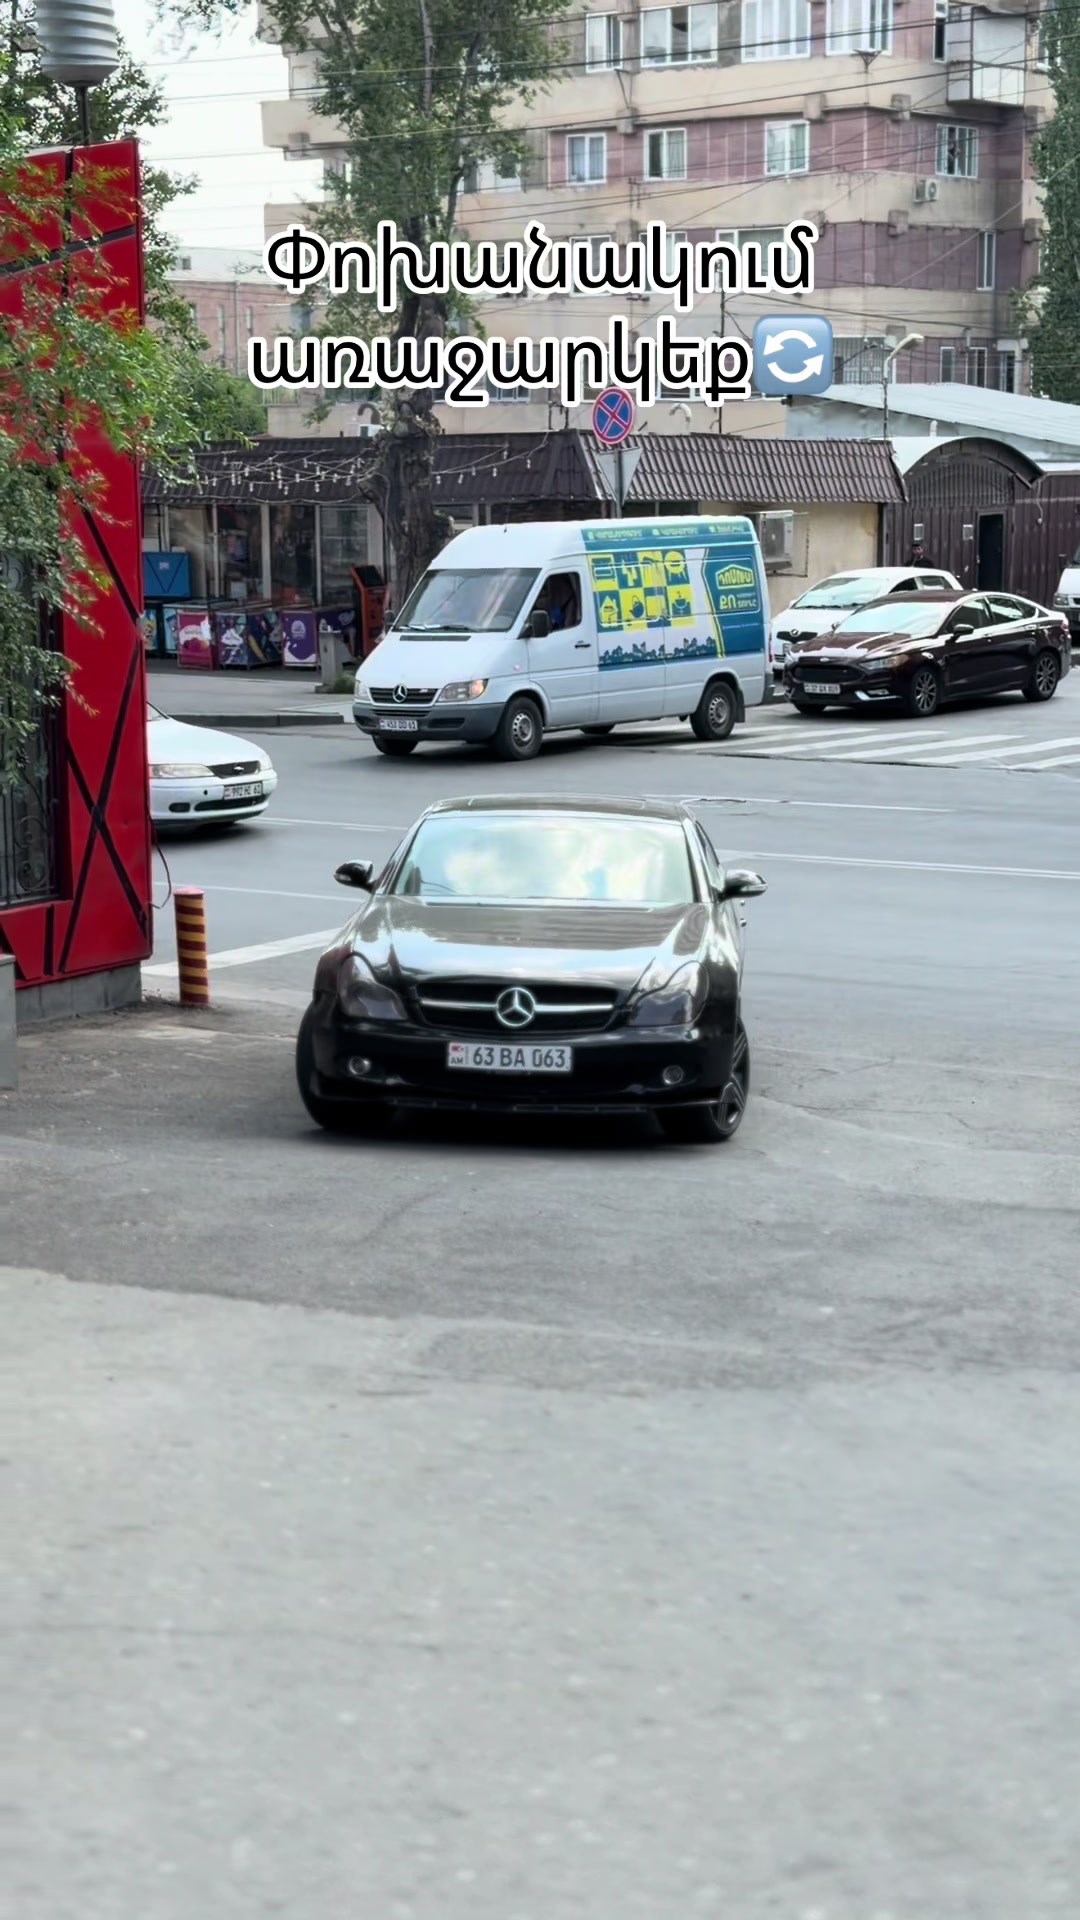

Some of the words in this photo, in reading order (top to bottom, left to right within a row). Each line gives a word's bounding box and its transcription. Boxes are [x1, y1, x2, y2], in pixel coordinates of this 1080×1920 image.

[451, 1056, 464, 1065] AM
[473, 1047, 495, 1066] 63
[500, 1047, 526, 1068] BA
[532, 1048, 566, 1068] 063
